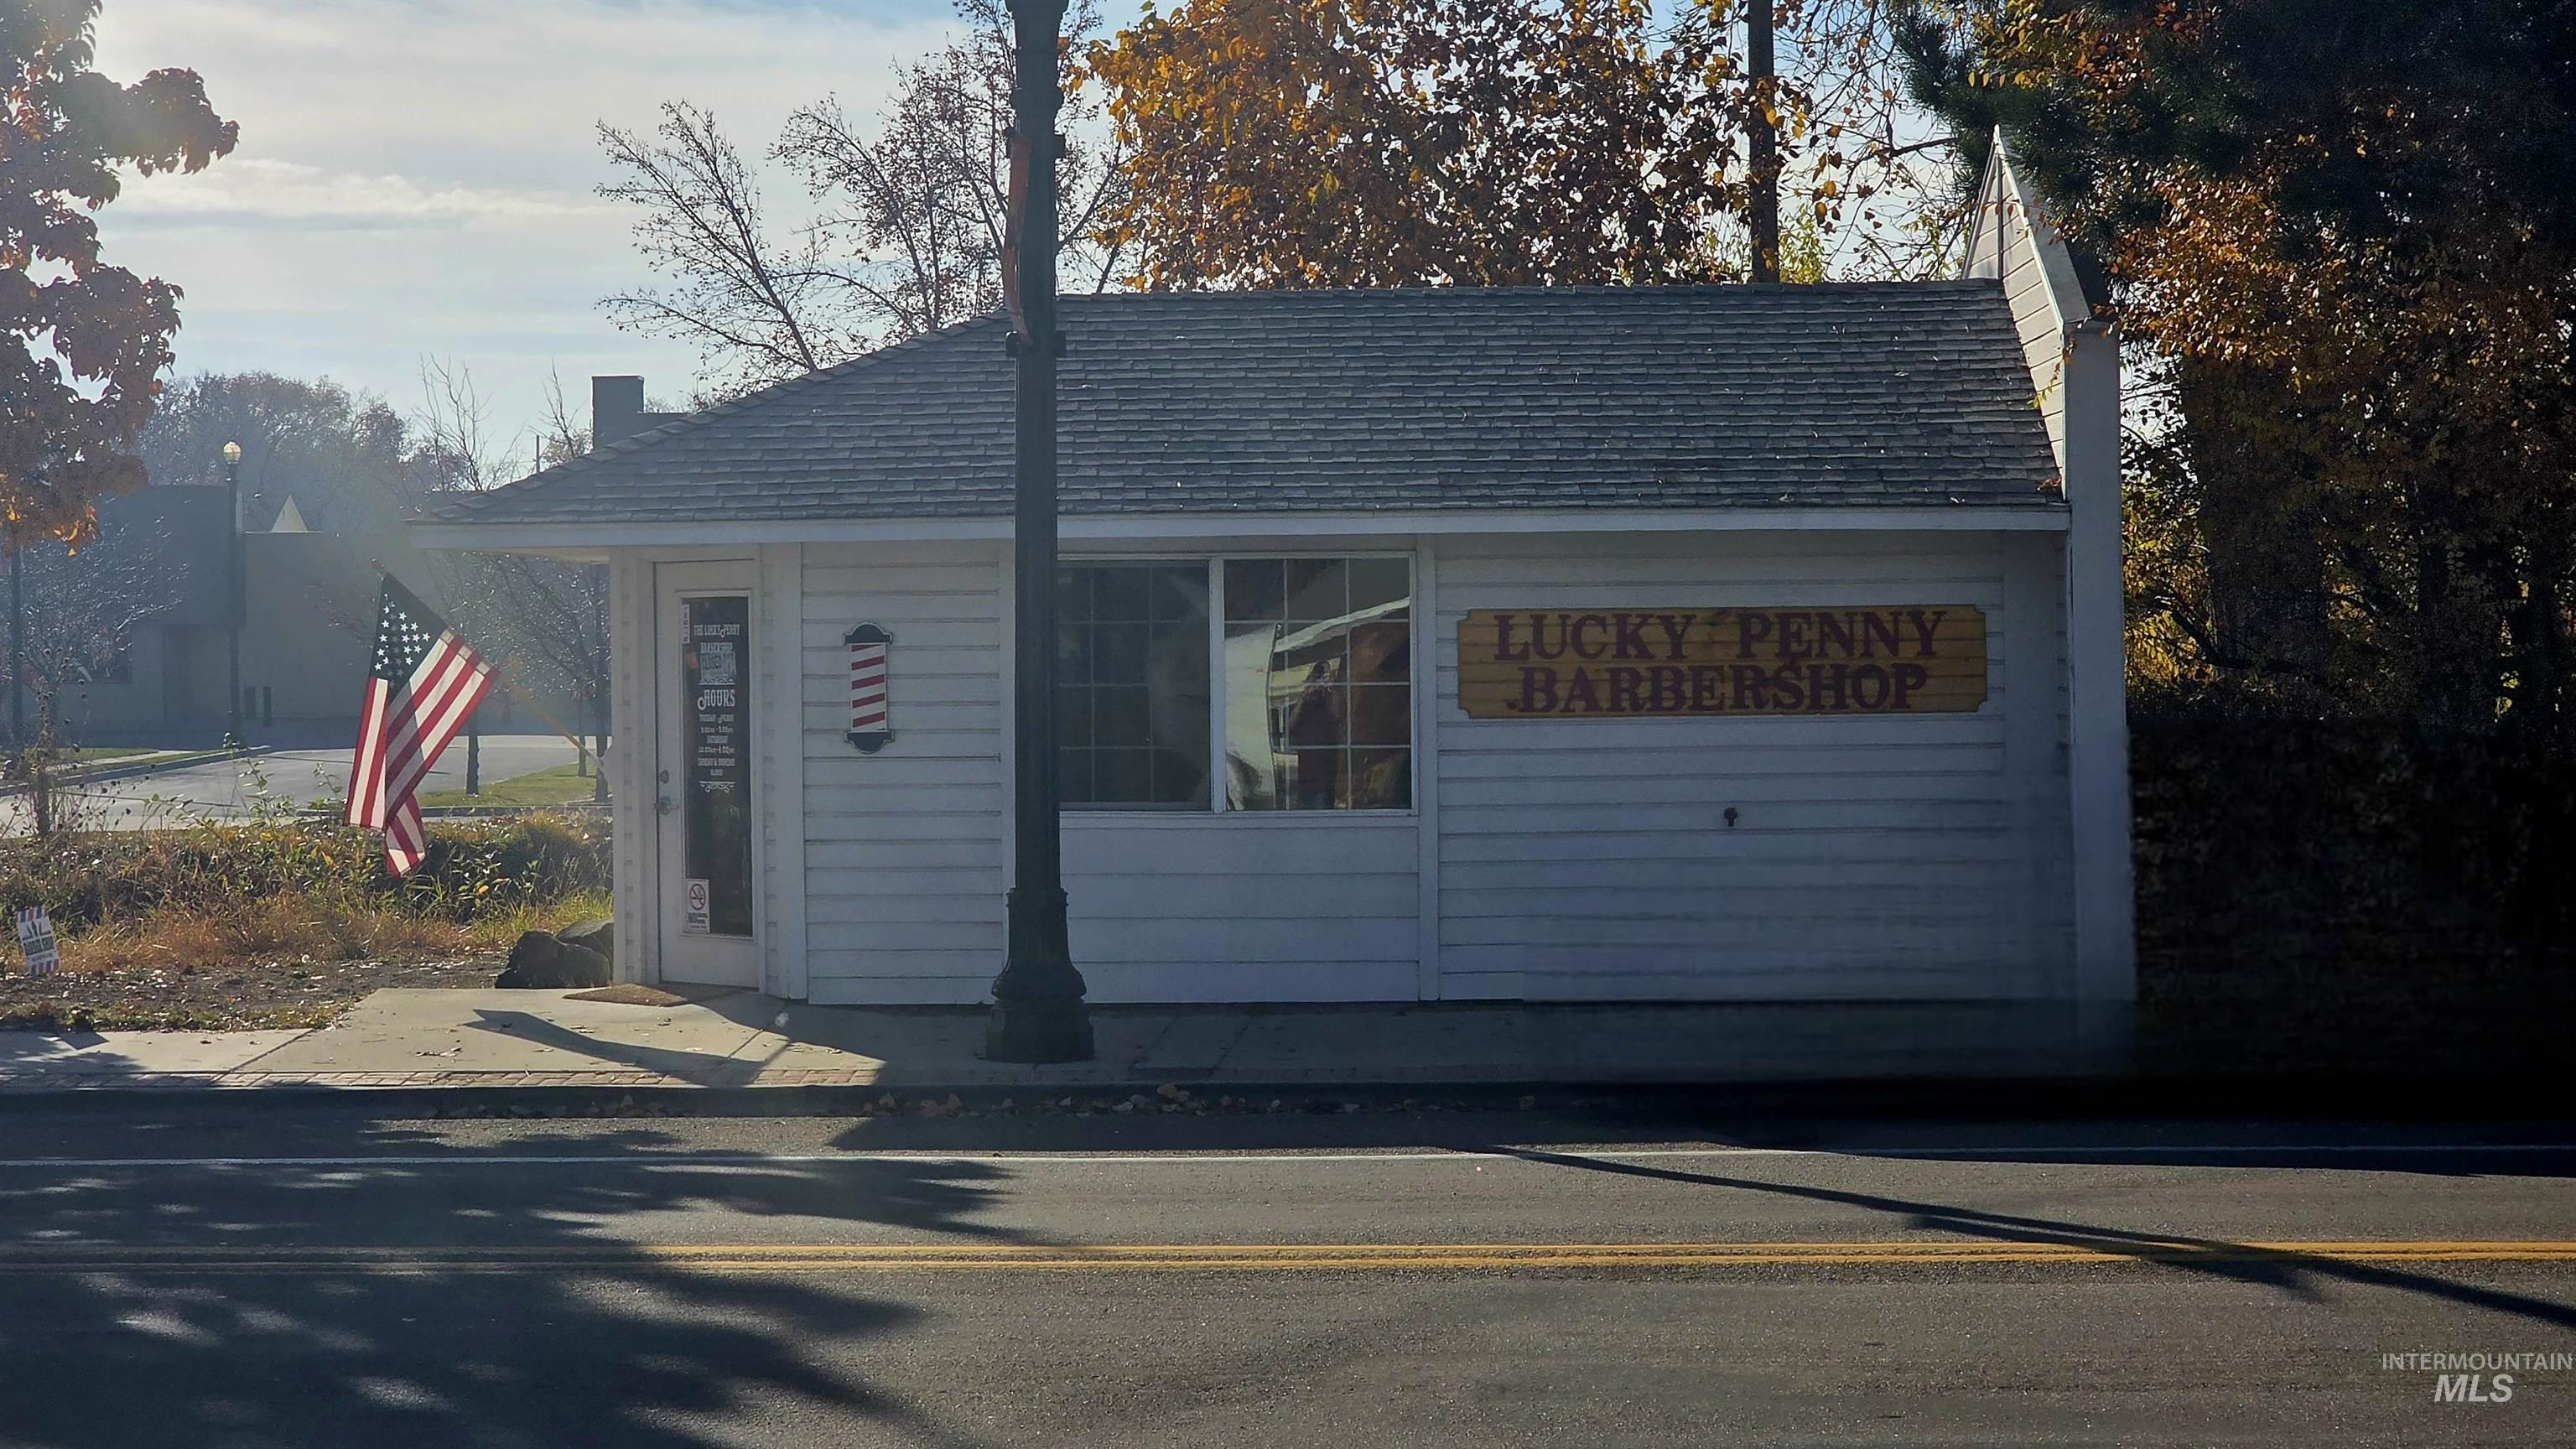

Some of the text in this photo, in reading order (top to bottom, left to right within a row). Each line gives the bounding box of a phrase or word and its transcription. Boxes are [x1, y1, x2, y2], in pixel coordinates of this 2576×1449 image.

[1493, 610, 1947, 662] LUCKY PENNY
[698, 689, 735, 711] HOURS
[1517, 662, 1929, 714] BARBERSHOP
